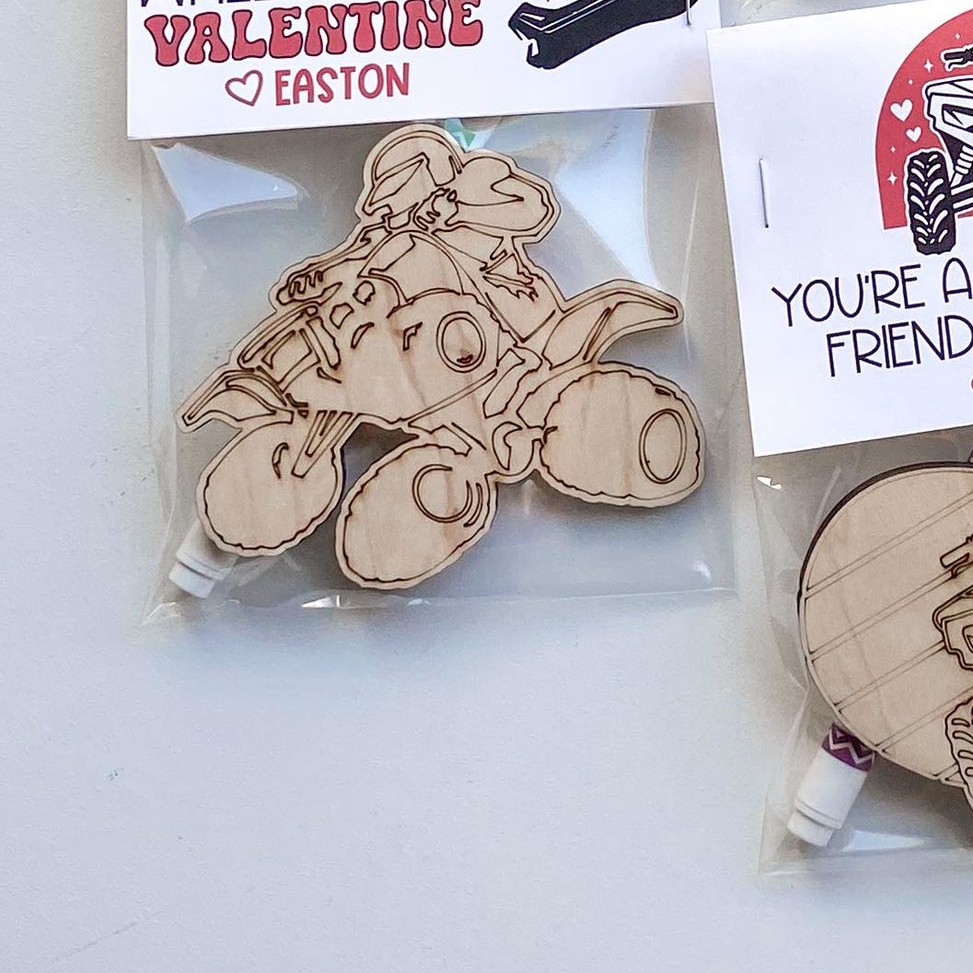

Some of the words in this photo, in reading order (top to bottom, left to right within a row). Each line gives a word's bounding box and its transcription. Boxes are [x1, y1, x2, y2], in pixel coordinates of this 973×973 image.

[274, 62, 410, 106] EASTON
[771, 264, 926, 327] YOU'RE
[942, 257, 973, 303] A
